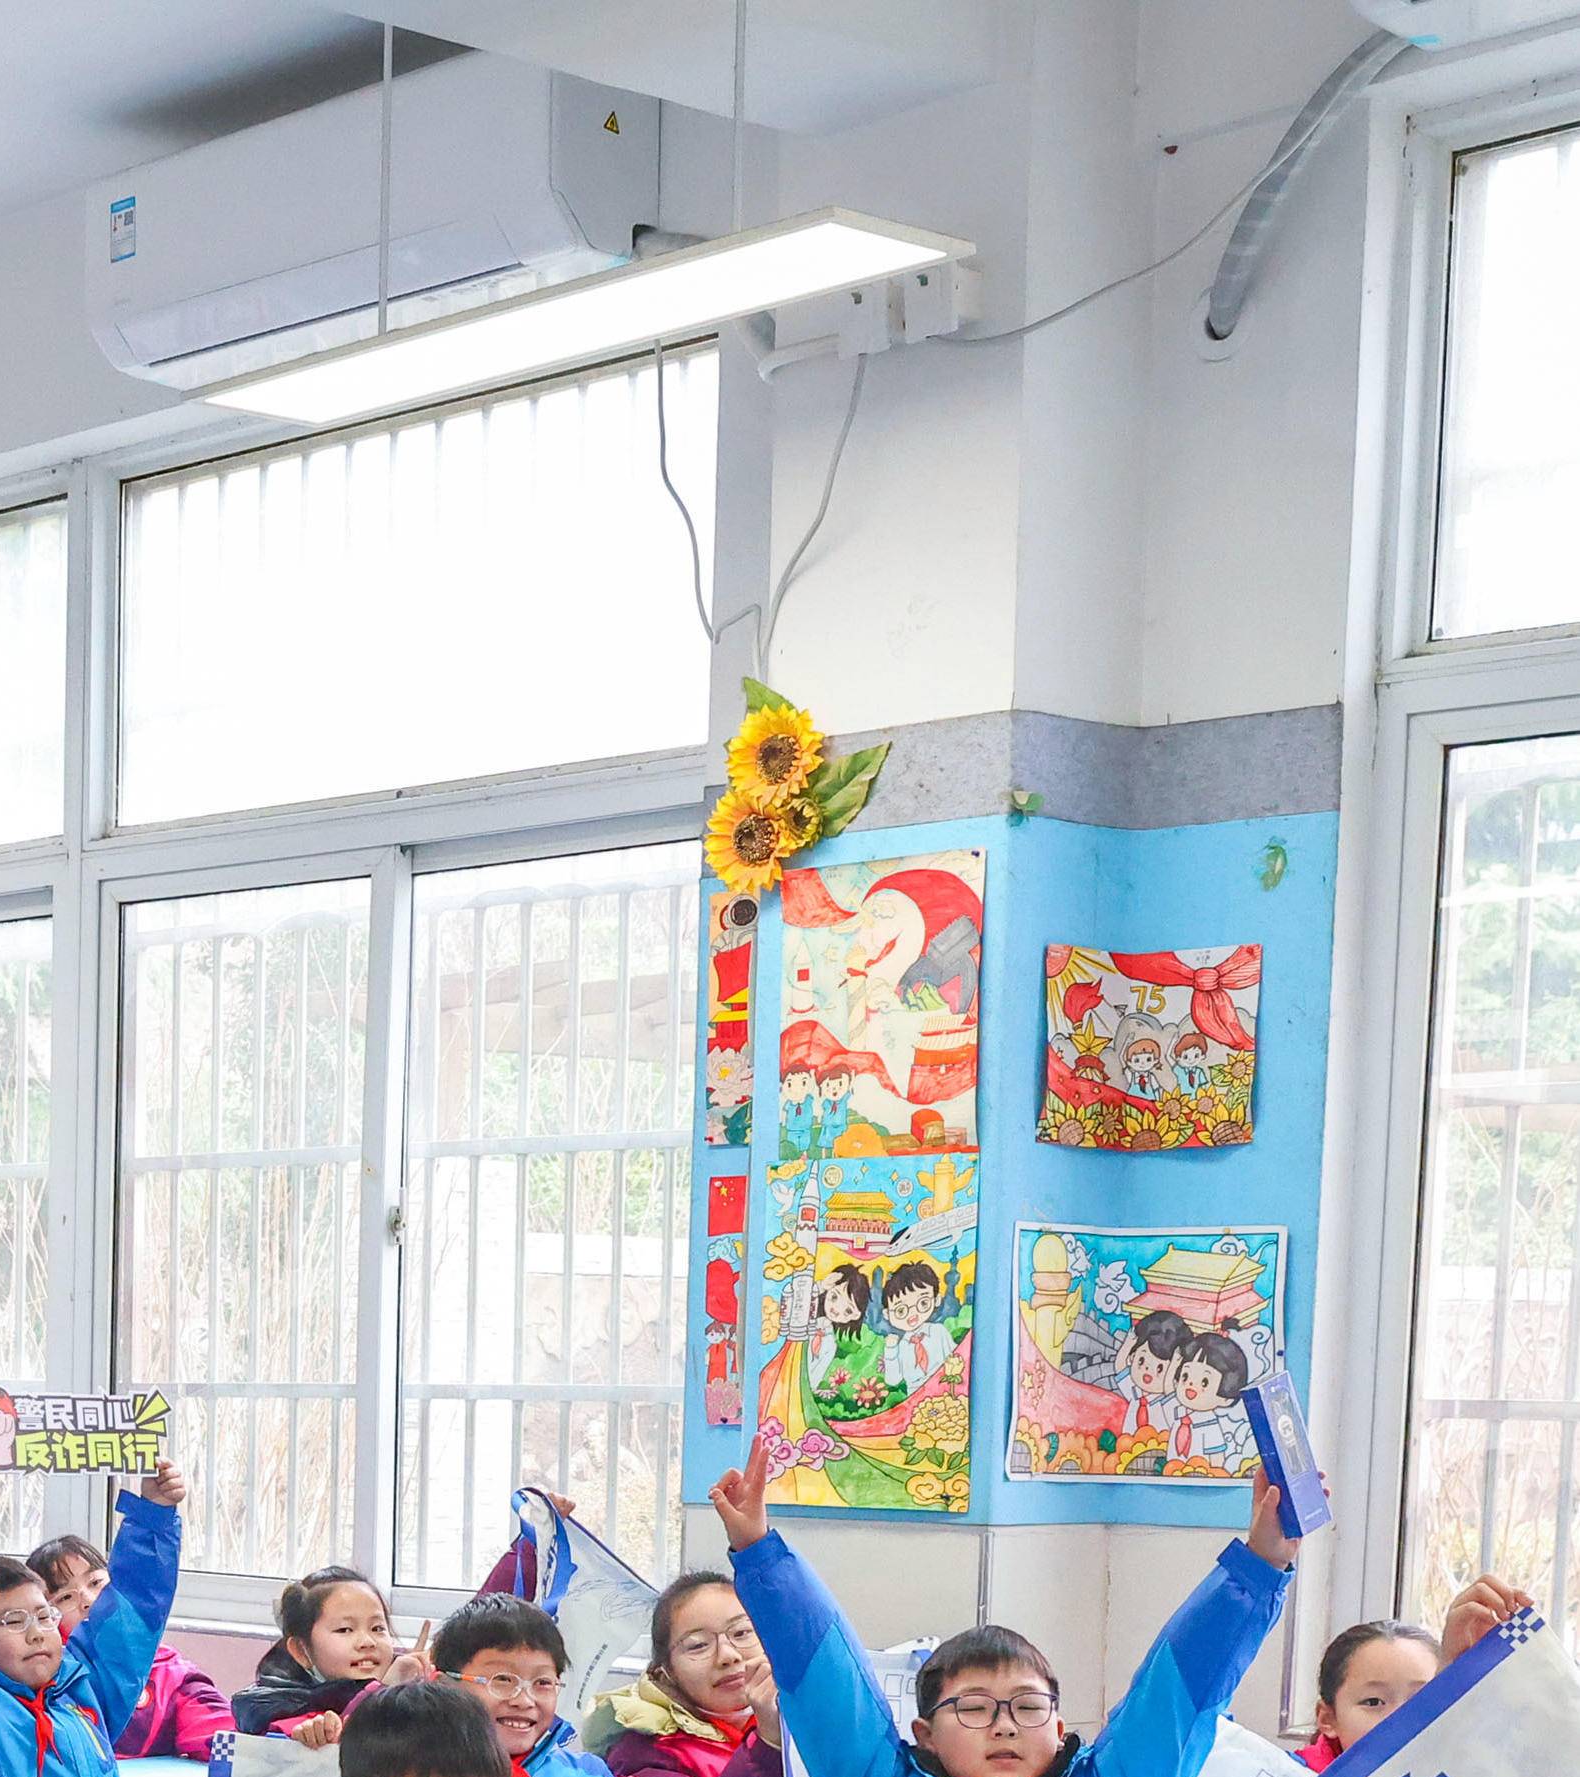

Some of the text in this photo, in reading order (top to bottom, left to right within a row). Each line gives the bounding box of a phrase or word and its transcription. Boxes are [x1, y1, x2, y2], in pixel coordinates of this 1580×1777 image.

[1129, 984, 1167, 1015] 75
[13, 1394, 135, 1433] 警民同心
[15, 1430, 159, 1473] 反诈同行
